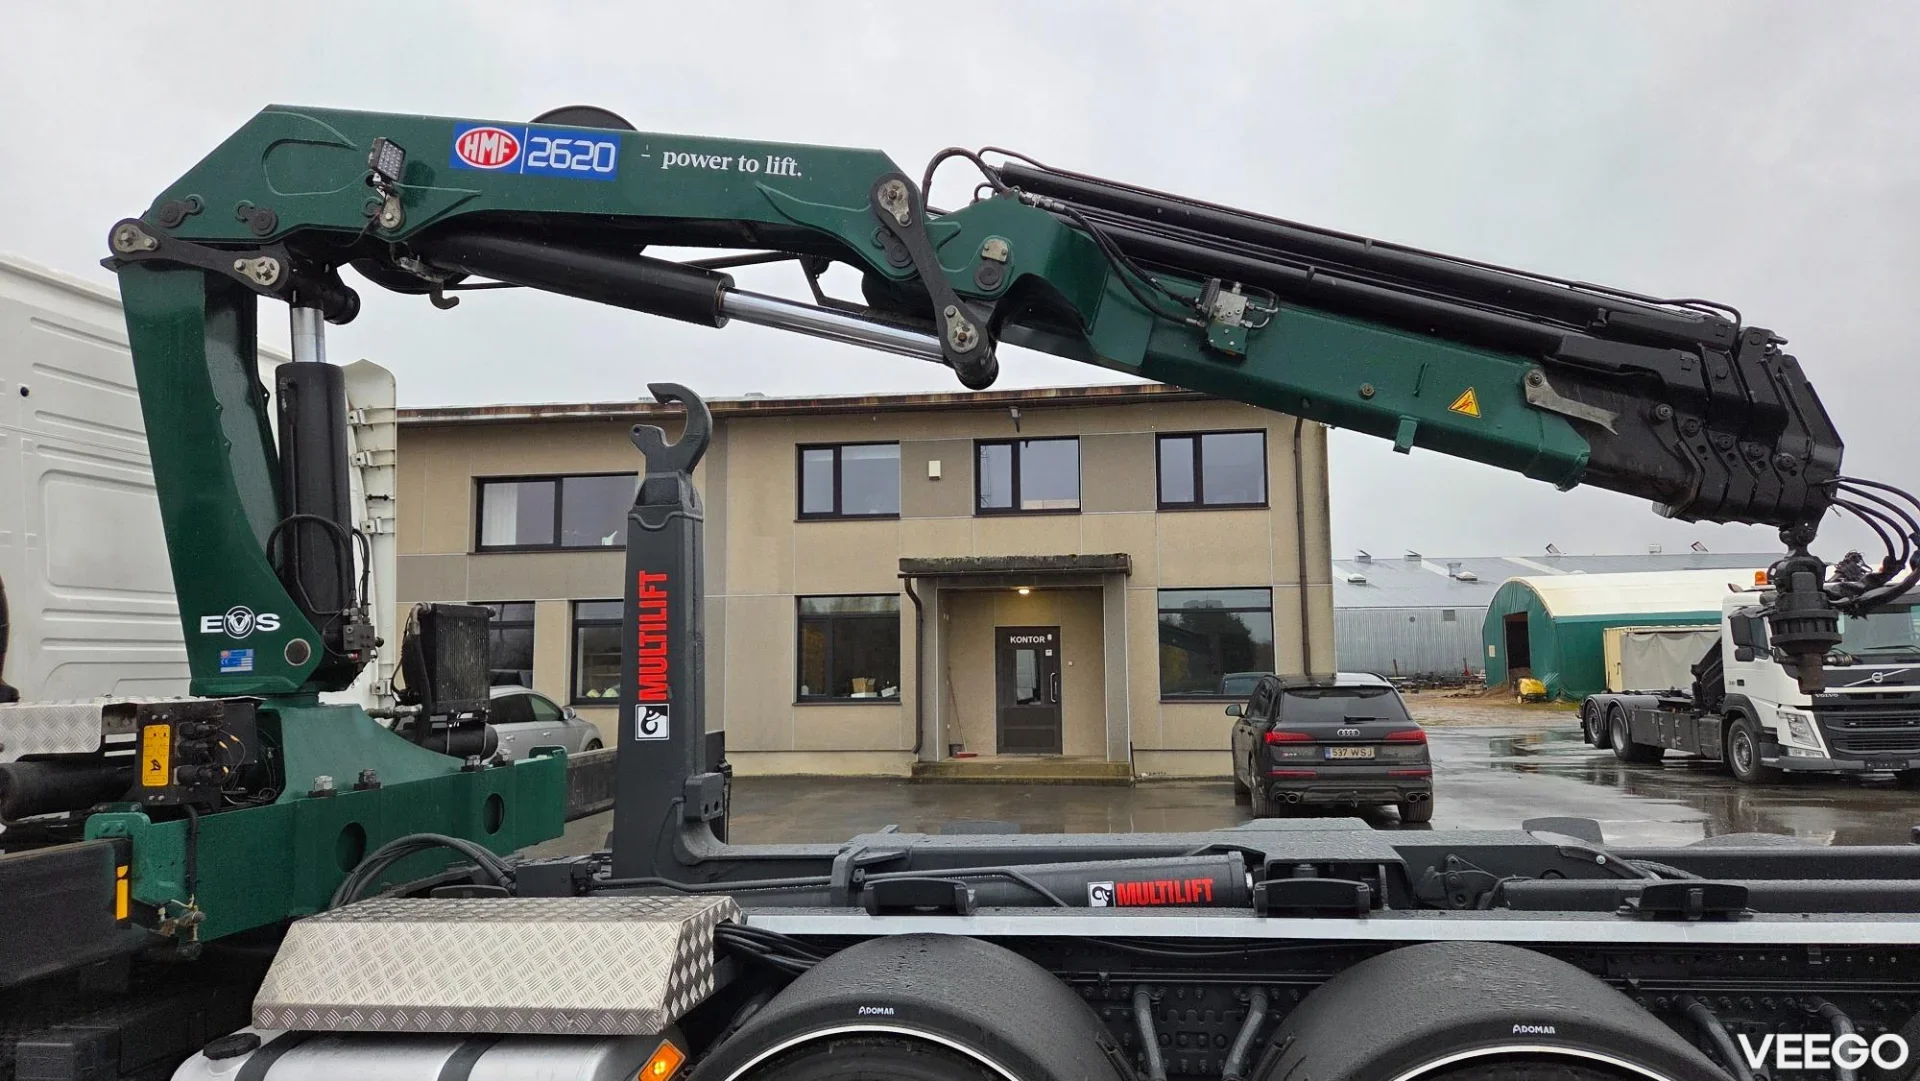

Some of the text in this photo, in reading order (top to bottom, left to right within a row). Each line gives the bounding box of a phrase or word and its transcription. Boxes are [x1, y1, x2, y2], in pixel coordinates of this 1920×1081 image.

[463, 132, 616, 173] HMF 2620
[662, 148, 802, 177] power to lift.
[639, 570, 667, 700] MULTILIFT
[1010, 635, 1046, 644] KONTOR
[1333, 748, 1347, 757] 537
[1116, 878, 1214, 908] MULTILIFT
[858, 1005, 895, 1015] ADOMAR
[1512, 1024, 1556, 1034] ADOMAR
